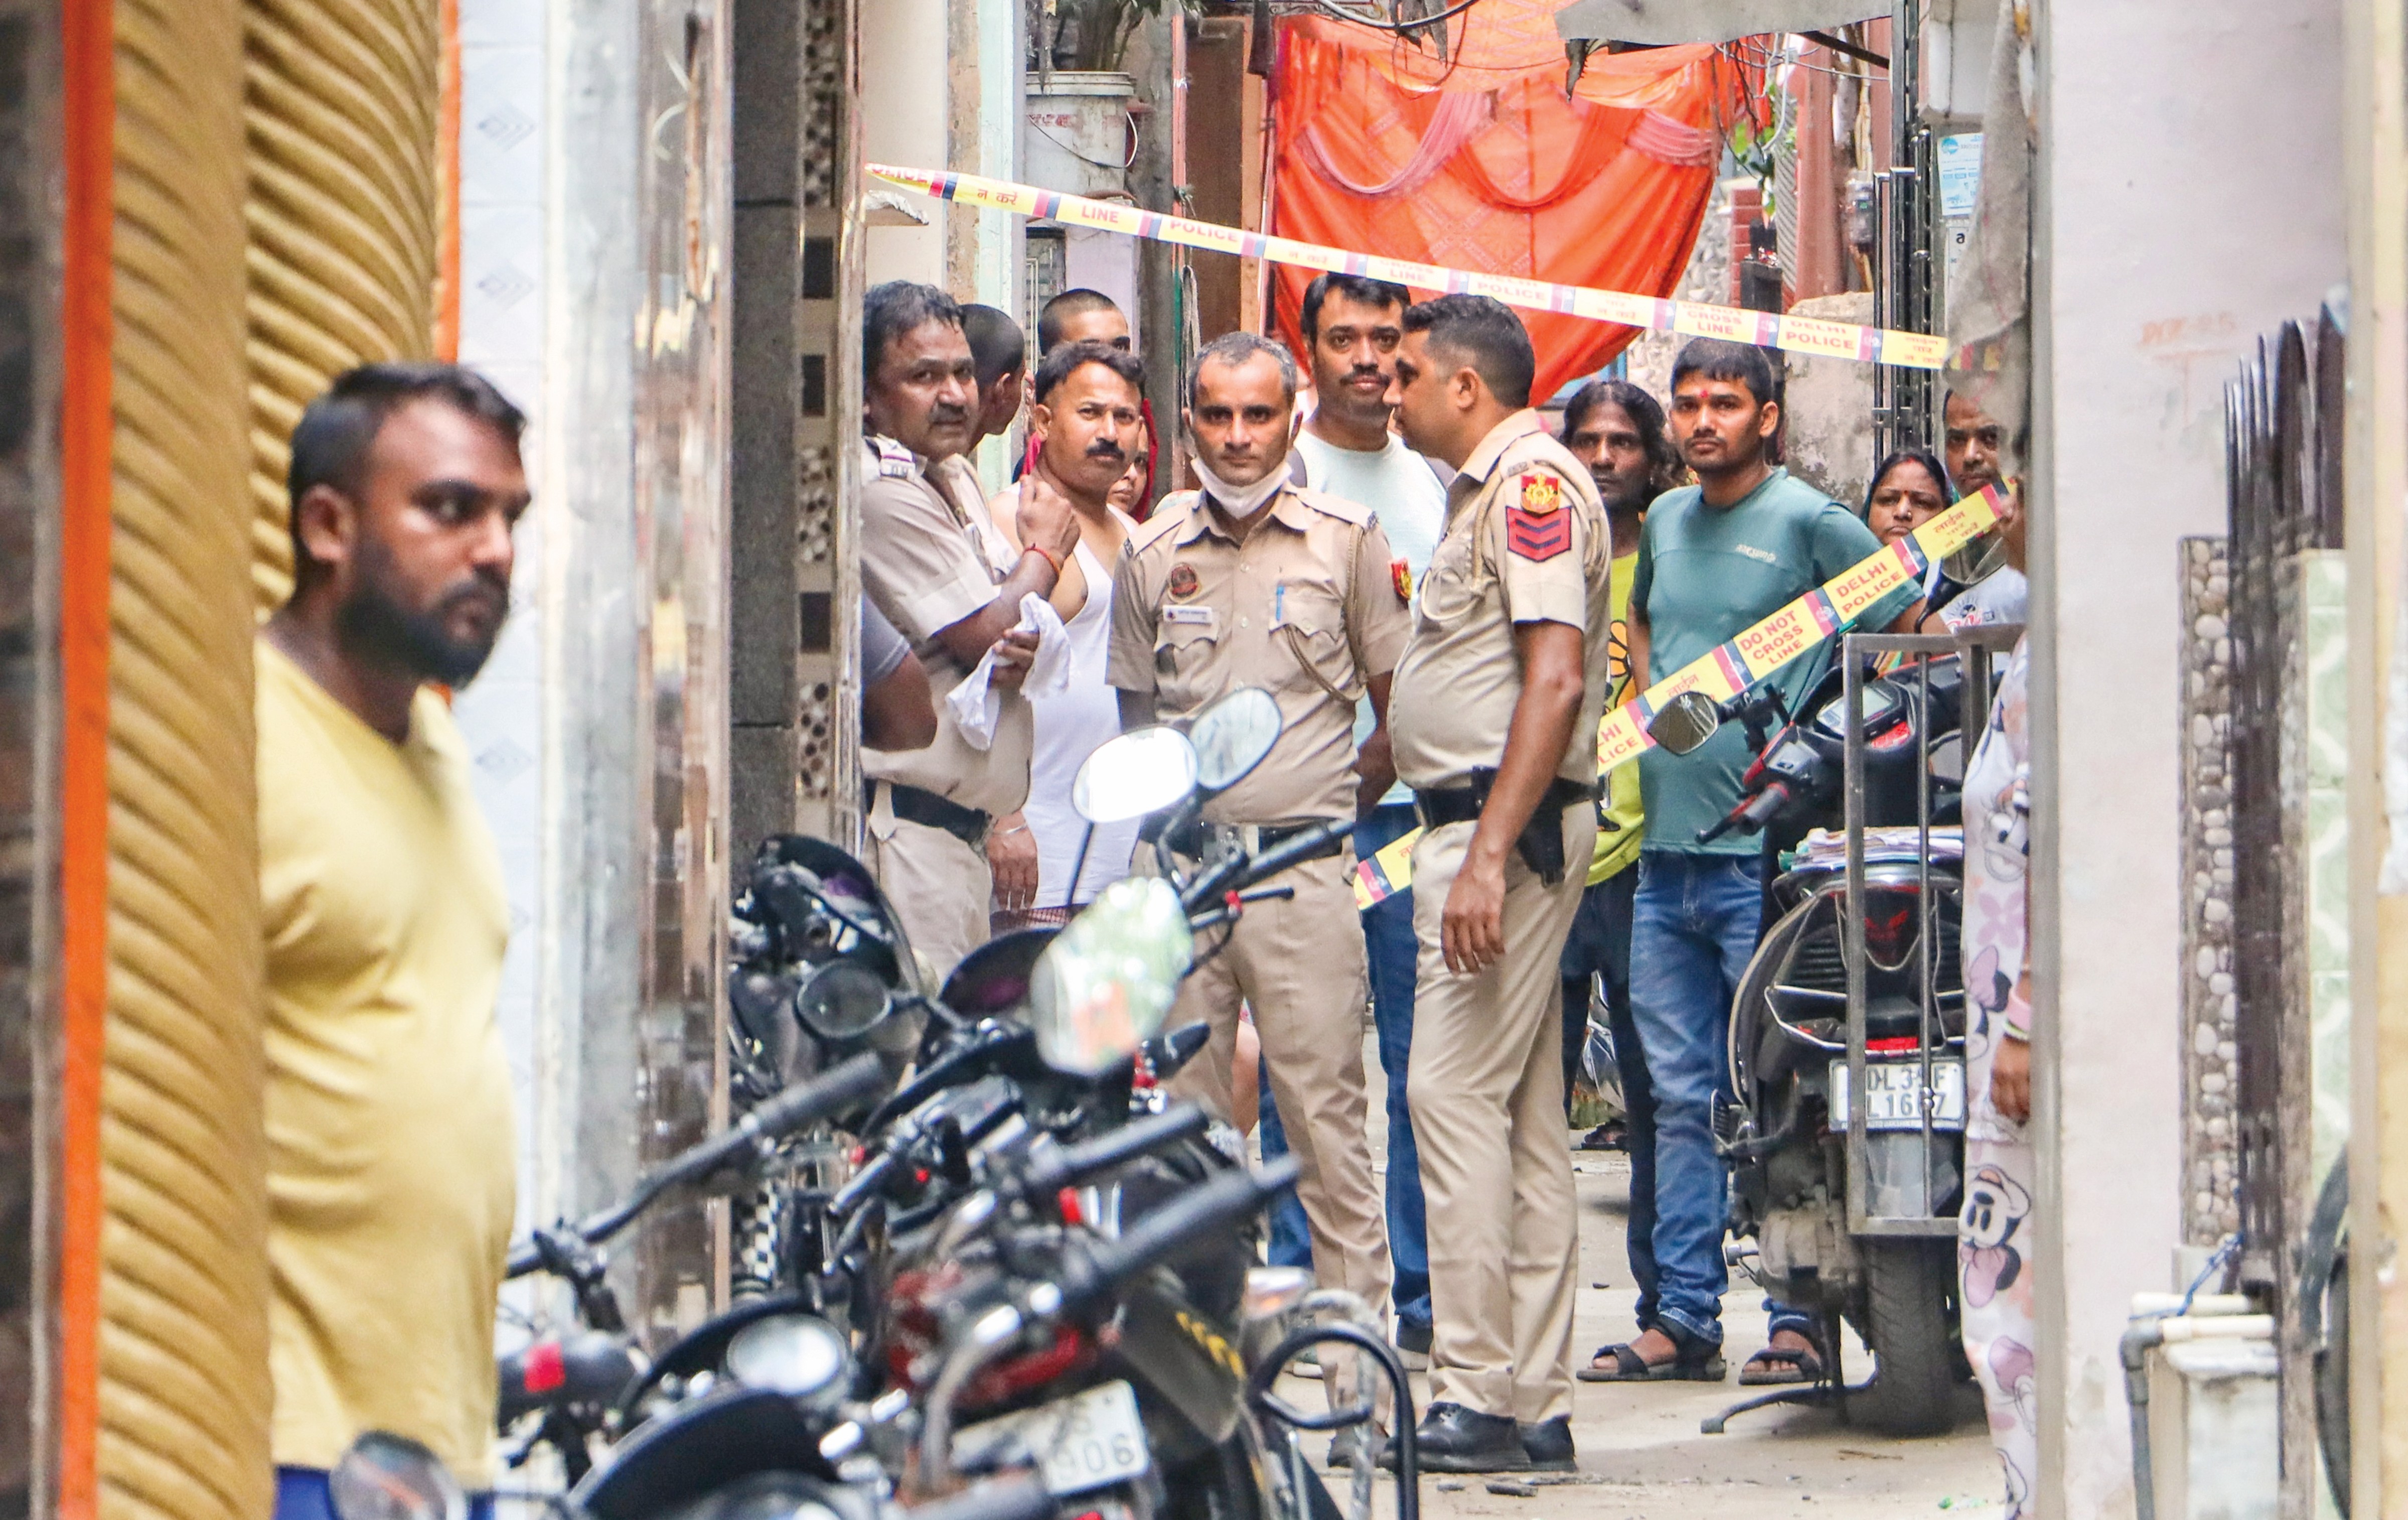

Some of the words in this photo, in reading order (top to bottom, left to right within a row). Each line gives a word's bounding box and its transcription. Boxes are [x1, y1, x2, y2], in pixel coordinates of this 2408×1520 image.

[1082, 205, 1119, 223] LINE
[1170, 220, 1238, 242] POLICE
[1390, 268, 1426, 282] LINE
[1477, 282, 1546, 301] POLICE
[1687, 310, 1742, 325] CROSS
[1698, 321, 1734, 335] LINE
[1790, 320, 1847, 334] DELHI
[1785, 331, 1855, 350] POLICE
[1836, 562, 1888, 598] DELHI
[1842, 571, 1902, 614] POLICE
[1739, 629, 1763, 652] DO
[1765, 610, 1799, 640] NOT
[1753, 625, 1803, 660] CROSS
[1769, 639, 1803, 665] LINE
[1598, 736, 1638, 764] LICE
[1867, 1092, 1945, 1117] L167
